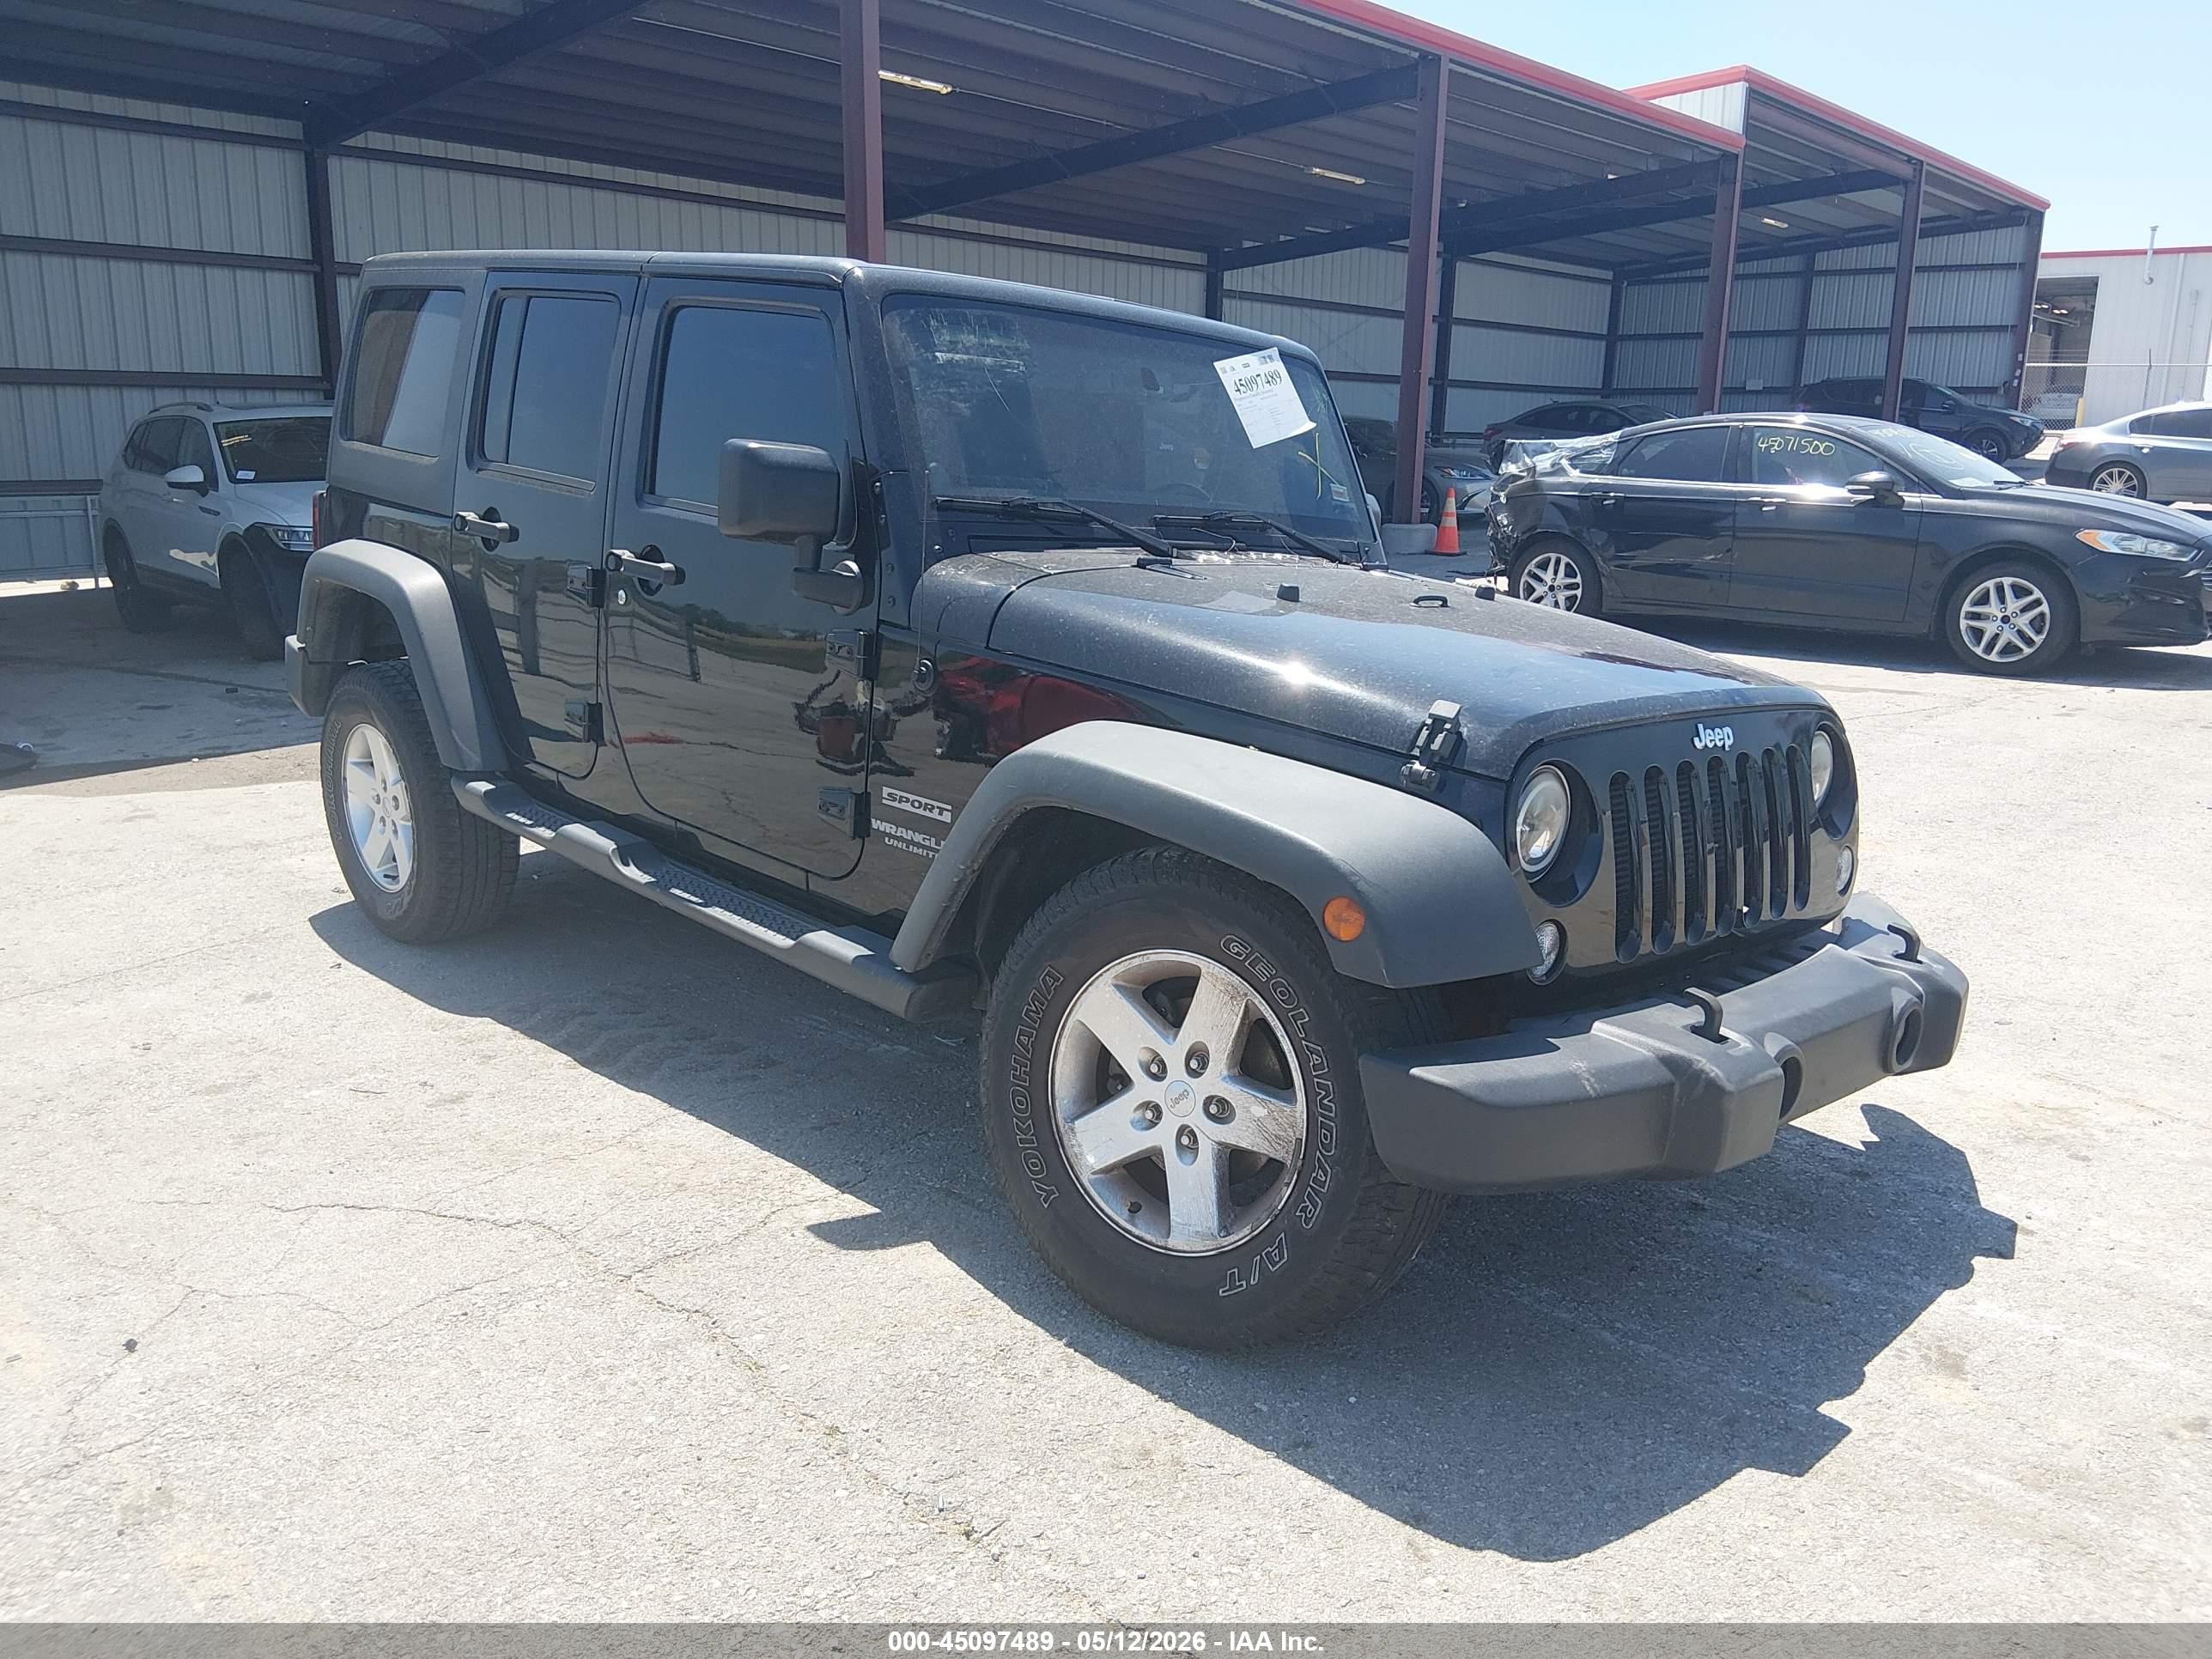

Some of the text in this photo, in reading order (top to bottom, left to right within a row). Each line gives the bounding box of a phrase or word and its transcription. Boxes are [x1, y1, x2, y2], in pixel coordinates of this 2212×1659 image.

[1233, 368, 1283, 396] 45097489
[1758, 436, 1836, 456] 45071500
[1693, 723, 1734, 751] Jeep
[886, 791, 947, 817] SPORT
[884, 836, 938, 860] UNLIMIT
[1008, 965, 1064, 1208] YOKOHAMA
[1170, 1089, 1189, 1109] Jeep
[1218, 933, 1338, 1297] GEOLANDAR A/T
